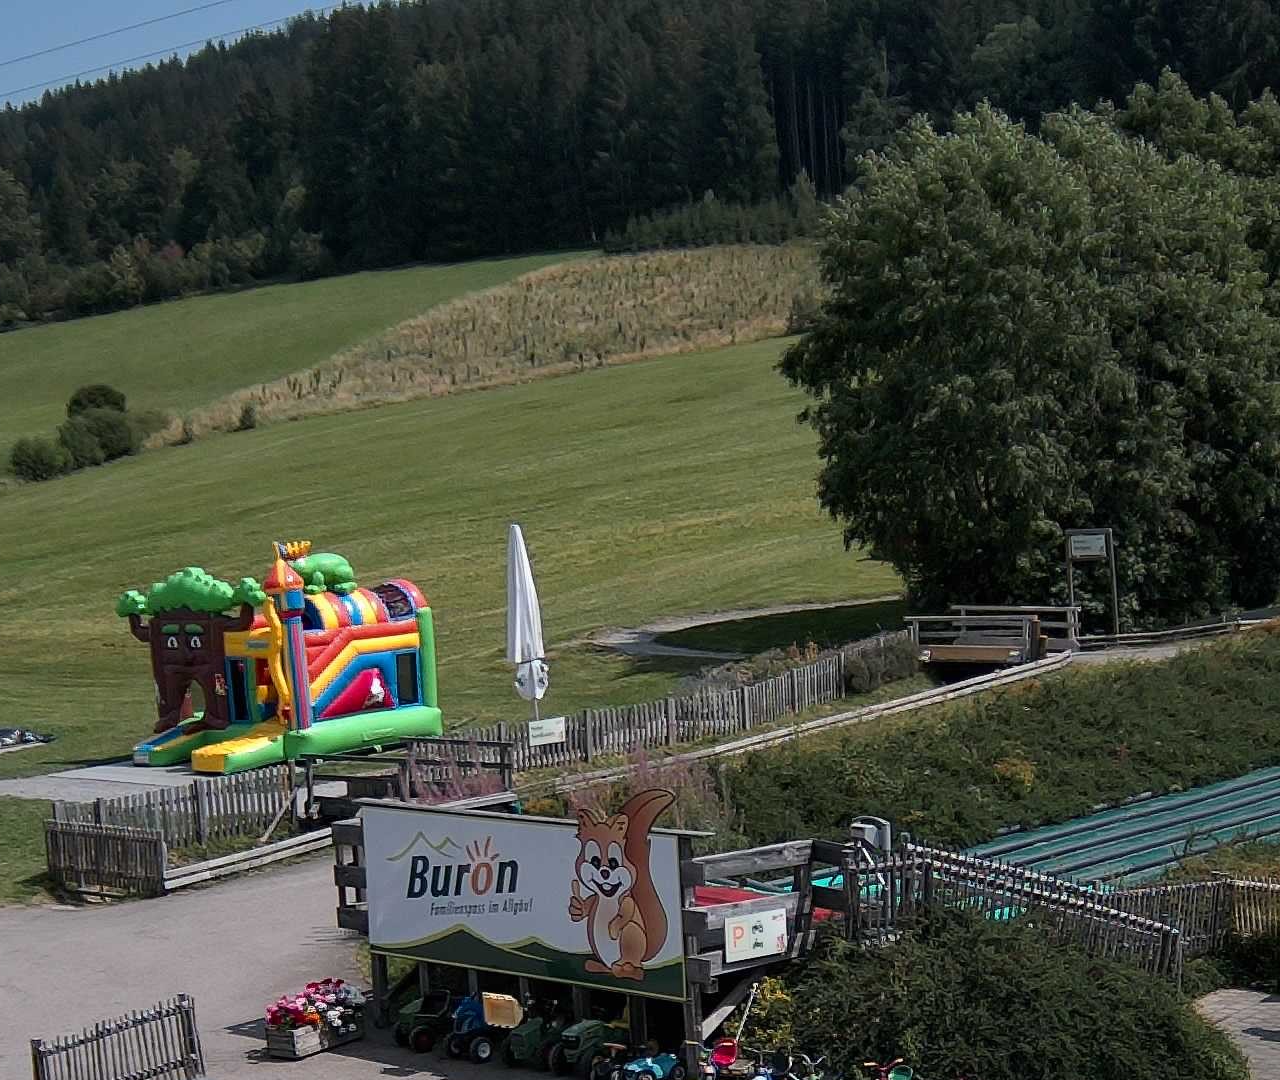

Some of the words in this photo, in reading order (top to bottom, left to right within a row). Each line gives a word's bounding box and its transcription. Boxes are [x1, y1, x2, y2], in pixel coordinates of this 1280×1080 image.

[407, 855, 519, 898] Buron
[488, 900, 499, 913] im
[733, 926, 745, 949] P
